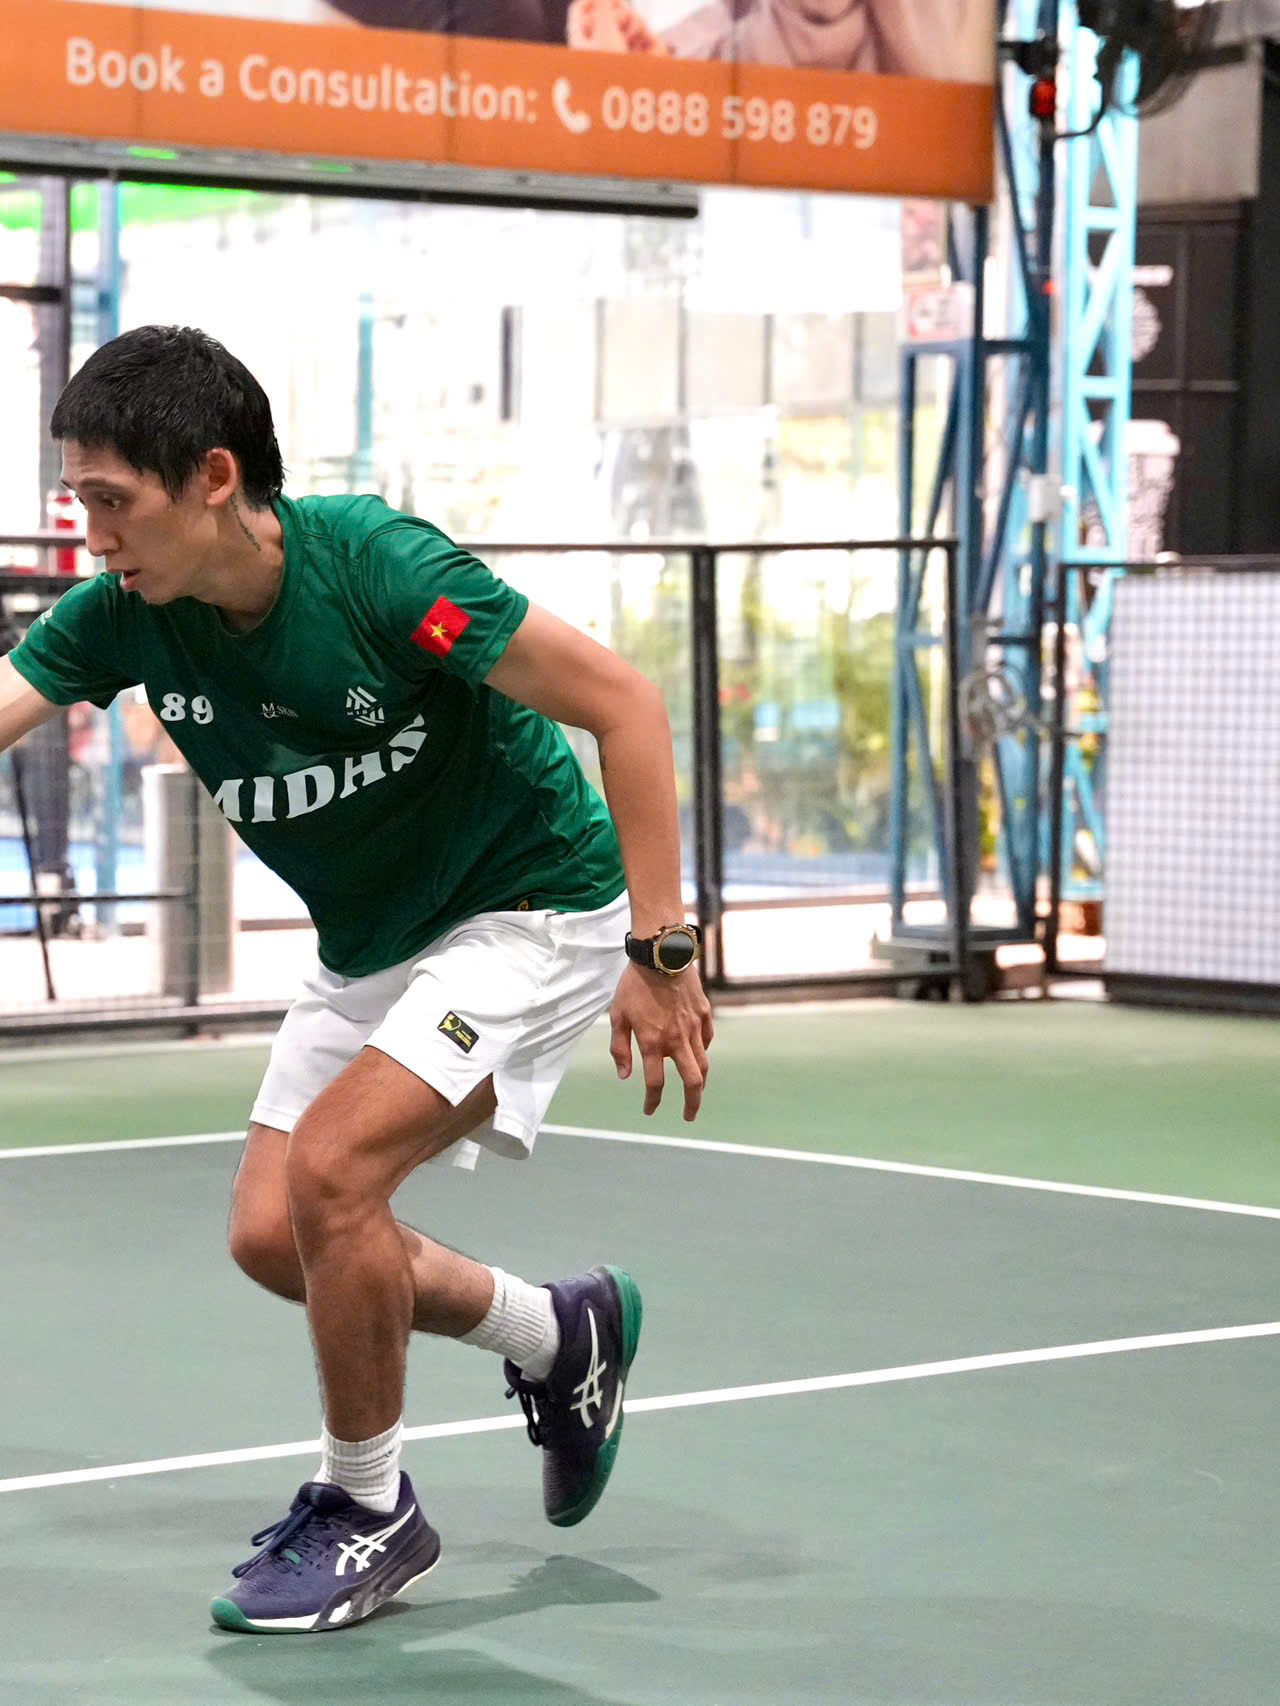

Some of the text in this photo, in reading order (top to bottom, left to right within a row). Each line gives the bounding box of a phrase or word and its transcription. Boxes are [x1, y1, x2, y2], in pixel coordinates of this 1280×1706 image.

[65, 36, 880, 151] Book a Consultation: 0888 598 879
[159, 692, 215, 725] 89
